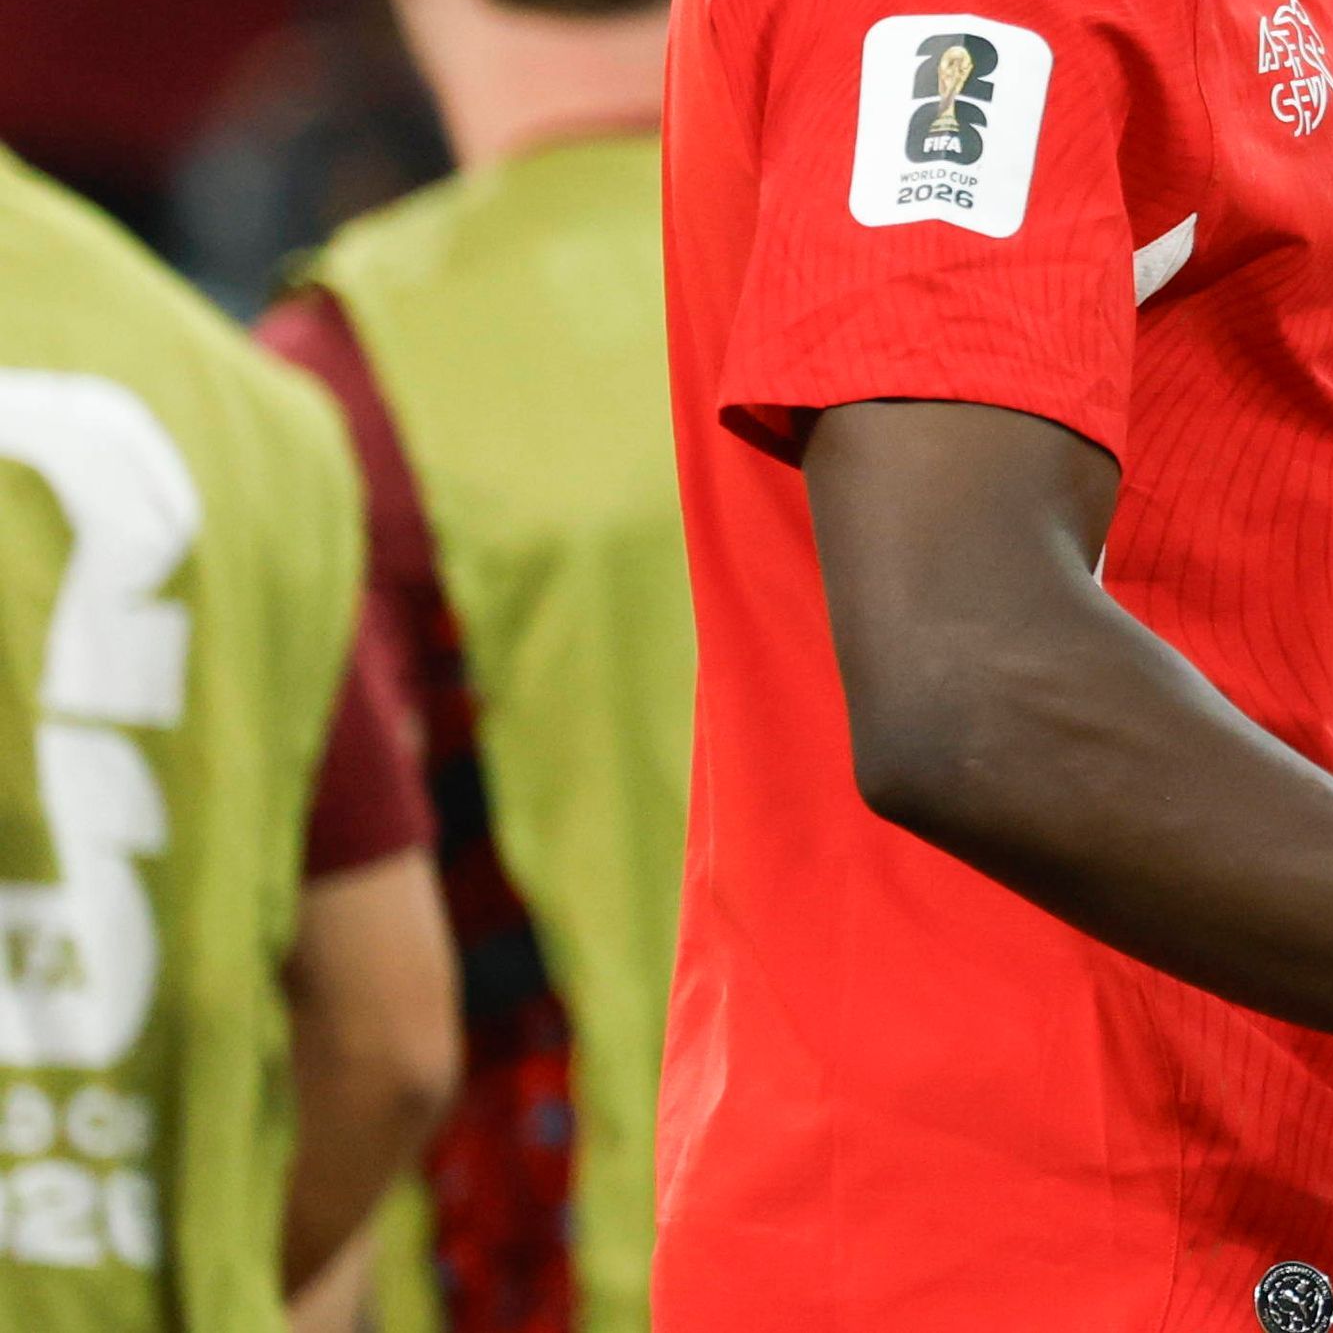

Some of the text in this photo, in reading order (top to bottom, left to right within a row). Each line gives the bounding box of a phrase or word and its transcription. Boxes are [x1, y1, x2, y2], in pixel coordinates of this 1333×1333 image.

[923, 135, 962, 153] FIFA
[901, 168, 978, 187] WORLD CUP
[897, 183, 974, 208] 2026
